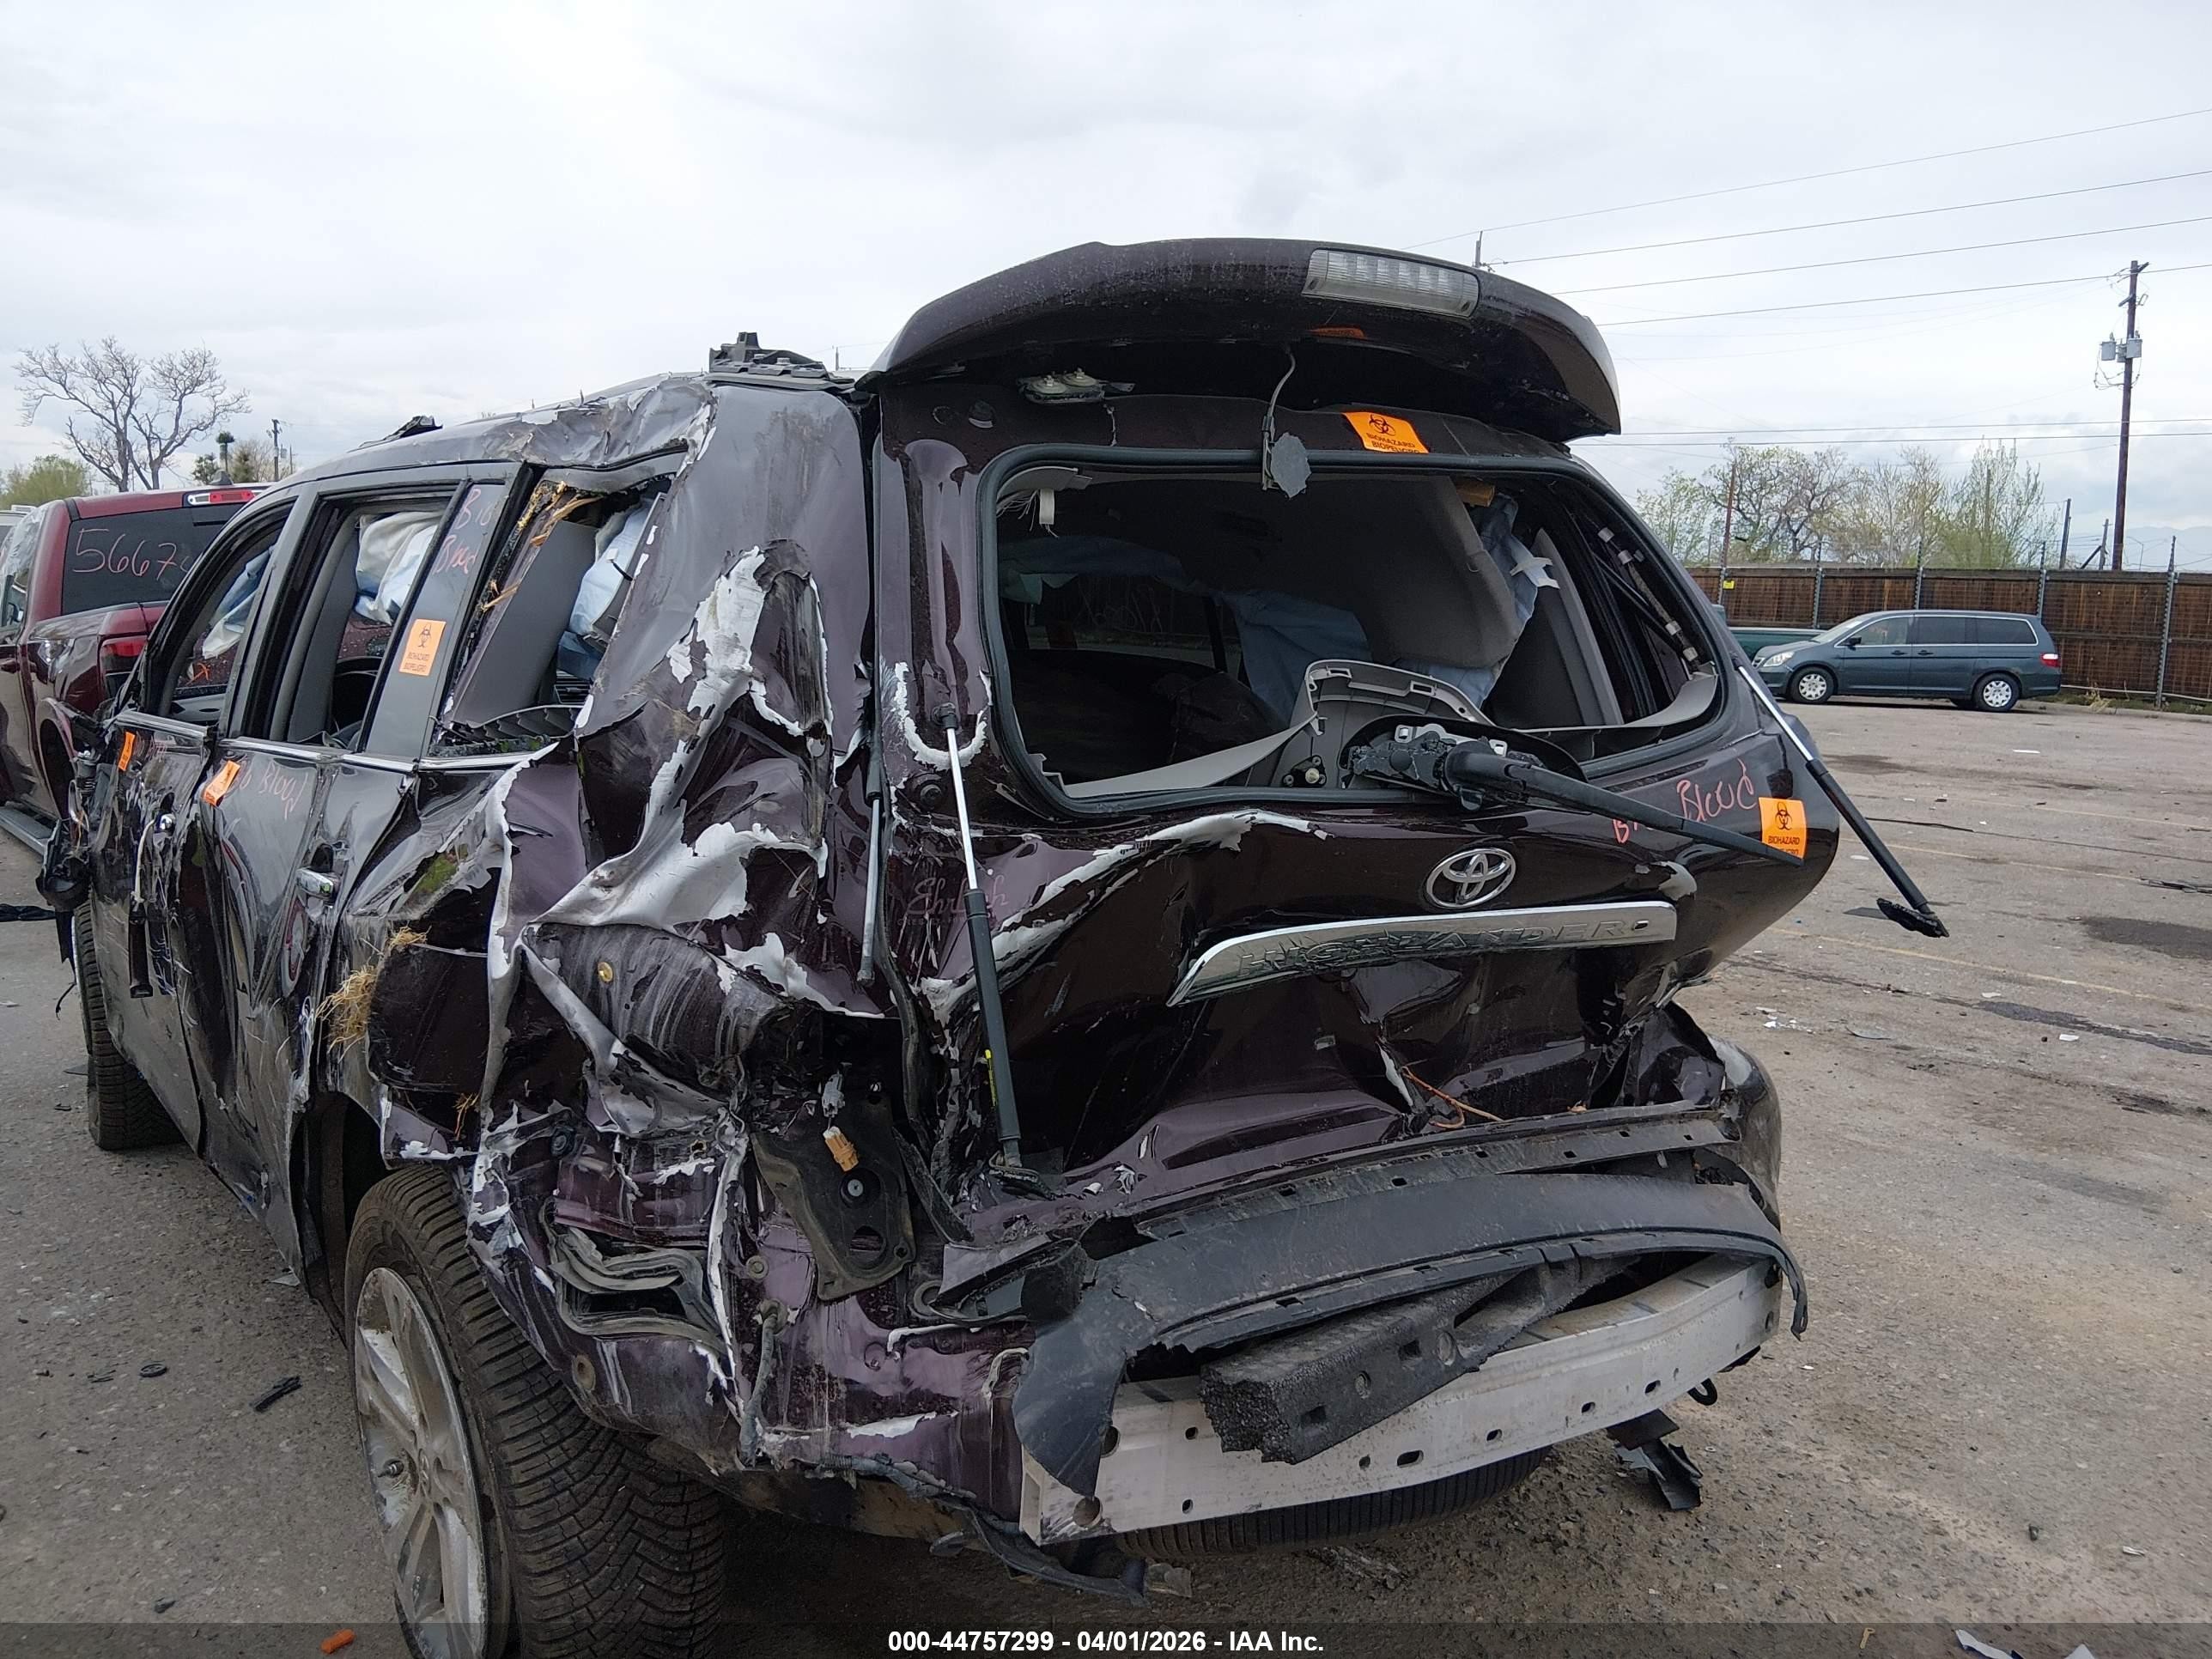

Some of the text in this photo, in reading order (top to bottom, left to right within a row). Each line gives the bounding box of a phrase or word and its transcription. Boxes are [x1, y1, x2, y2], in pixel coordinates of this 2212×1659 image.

[1365, 432, 1416, 448] BIOHAZARD
[1767, 835, 1801, 846] BIOHAZARD
[1237, 921, 1626, 977] HIGHLANDER
